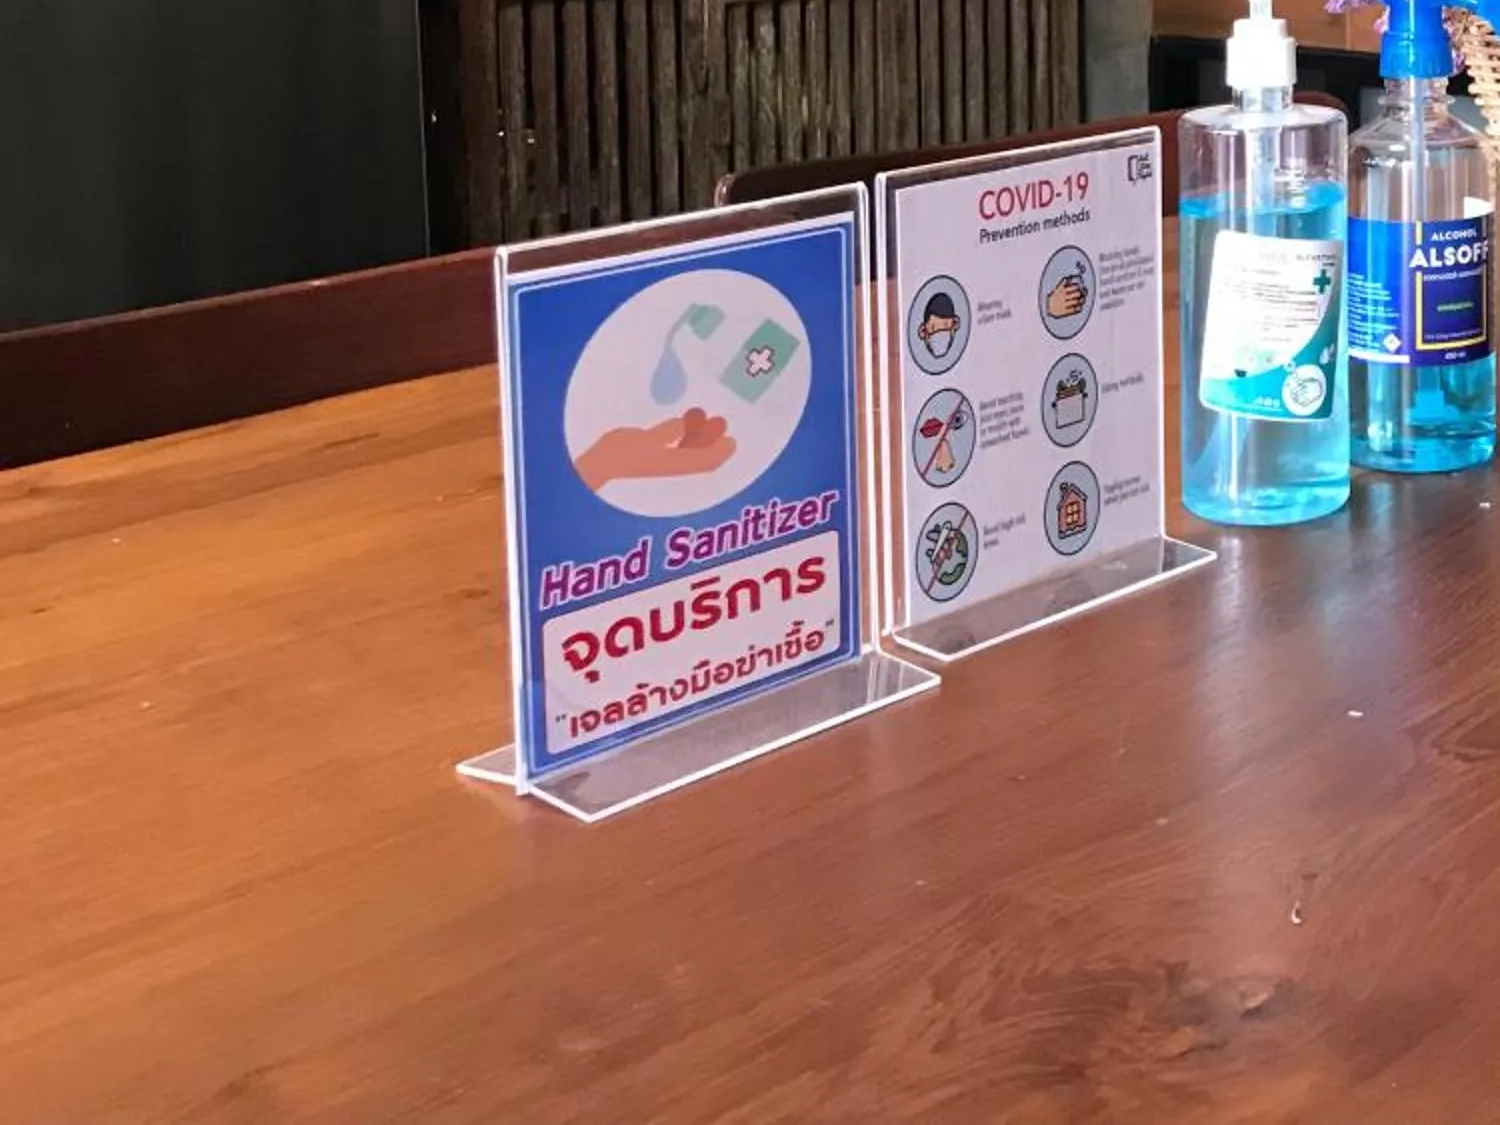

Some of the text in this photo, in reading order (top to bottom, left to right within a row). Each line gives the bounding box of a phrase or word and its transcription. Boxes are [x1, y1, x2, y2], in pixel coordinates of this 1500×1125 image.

[979, 171, 1089, 220] COVID-19
[979, 206, 1091, 244] Prevention methods
[1431, 228, 1477, 242] ALCOHOL
[540, 490, 838, 610] Hand Sanitizer
[560, 555, 827, 684] จุดบริการ
